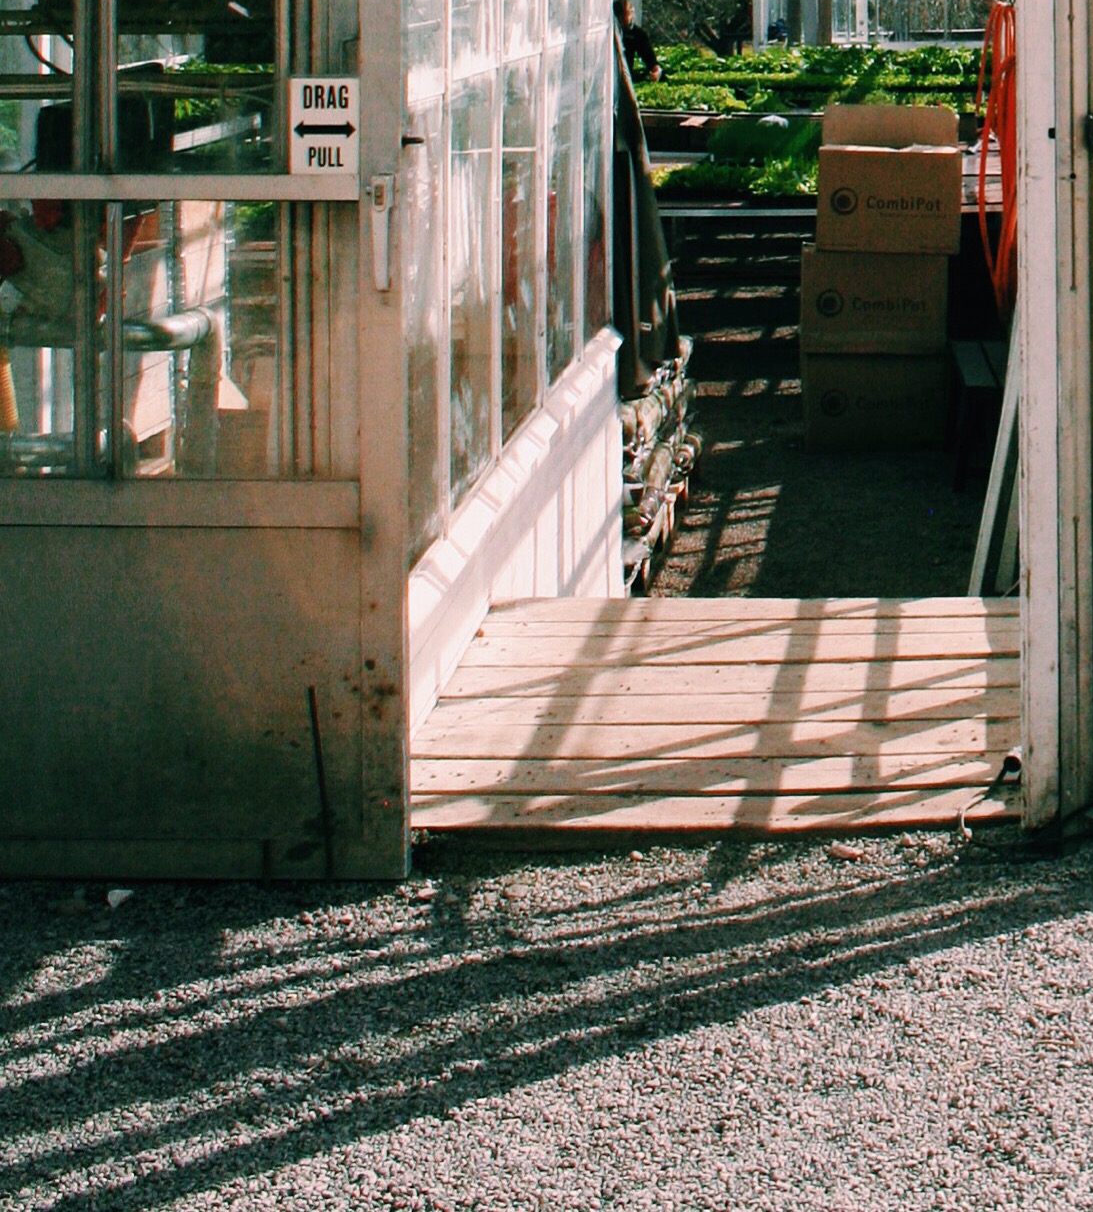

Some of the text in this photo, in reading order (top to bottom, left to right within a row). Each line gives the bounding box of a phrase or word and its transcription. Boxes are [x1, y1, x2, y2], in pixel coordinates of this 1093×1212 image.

[302, 84, 349, 109] DRAG
[308, 146, 344, 167] PULL
[866, 195, 942, 211] CombiPot
